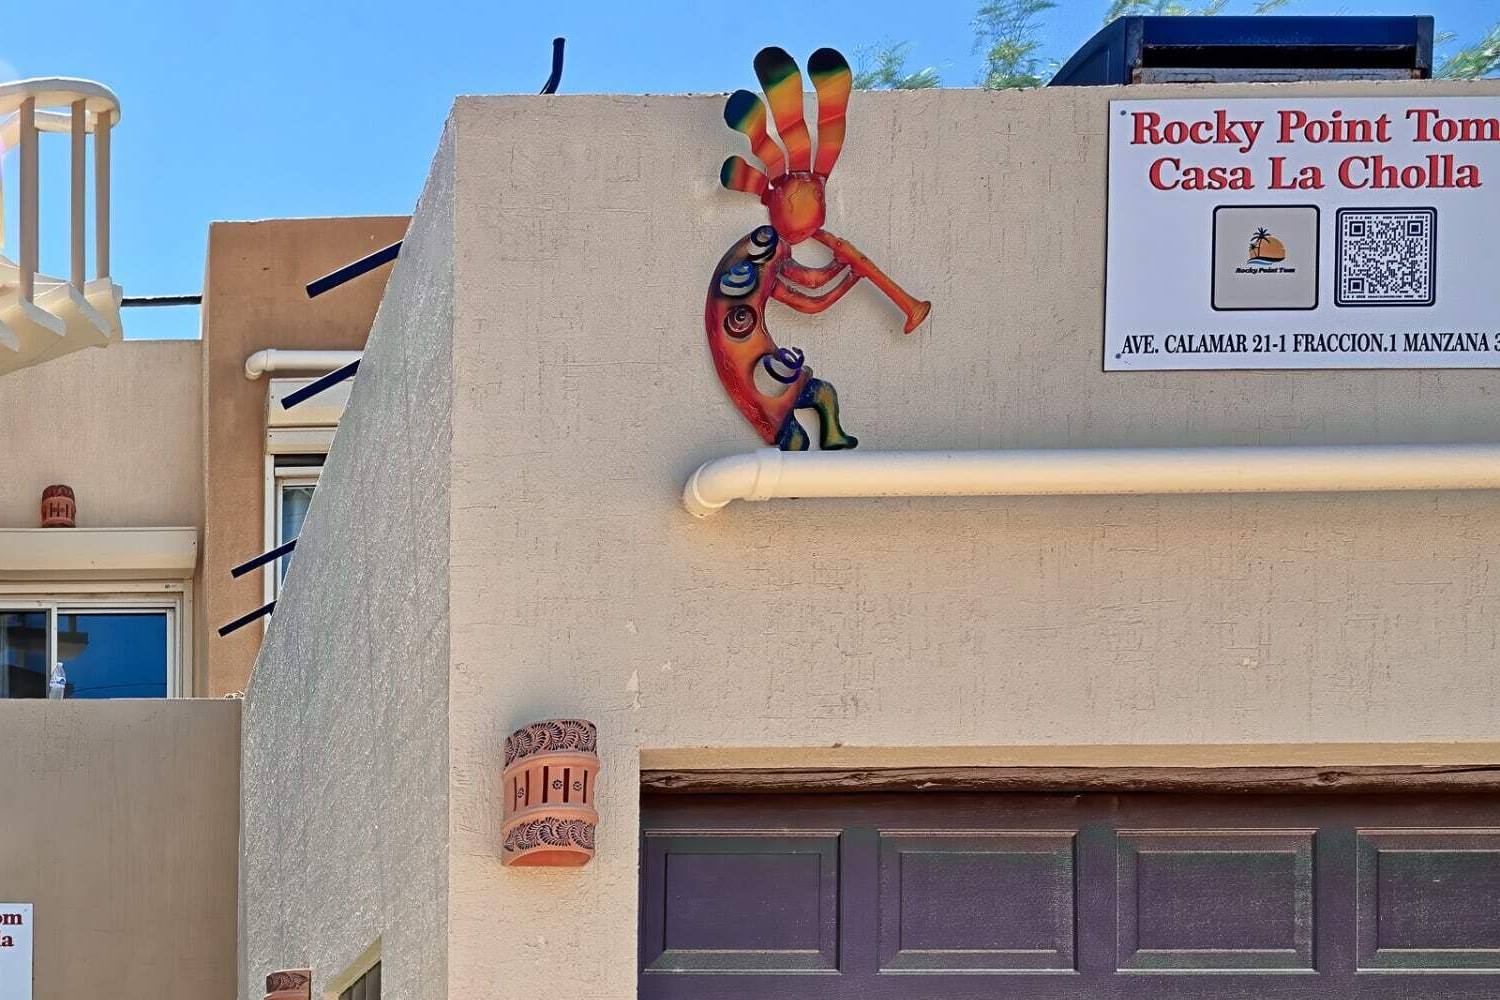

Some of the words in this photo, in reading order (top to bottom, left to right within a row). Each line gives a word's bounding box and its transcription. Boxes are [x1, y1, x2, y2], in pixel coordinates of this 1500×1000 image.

[1130, 110, 1264, 153] Rocky
[1276, 110, 1392, 143] Point
[1406, 109, 1500, 142] Tom
[1149, 157, 1255, 190] Casa
[1268, 156, 1325, 190] La
[1338, 154, 1483, 189] Cholla
[1122, 335, 1159, 355] AVE.
[1164, 334, 1248, 354] CALAMAR
[1253, 334, 1287, 353] 21-1
[1293, 333, 1397, 353] FRACCION.1
[1403, 332, 1490, 352] MANZANA
